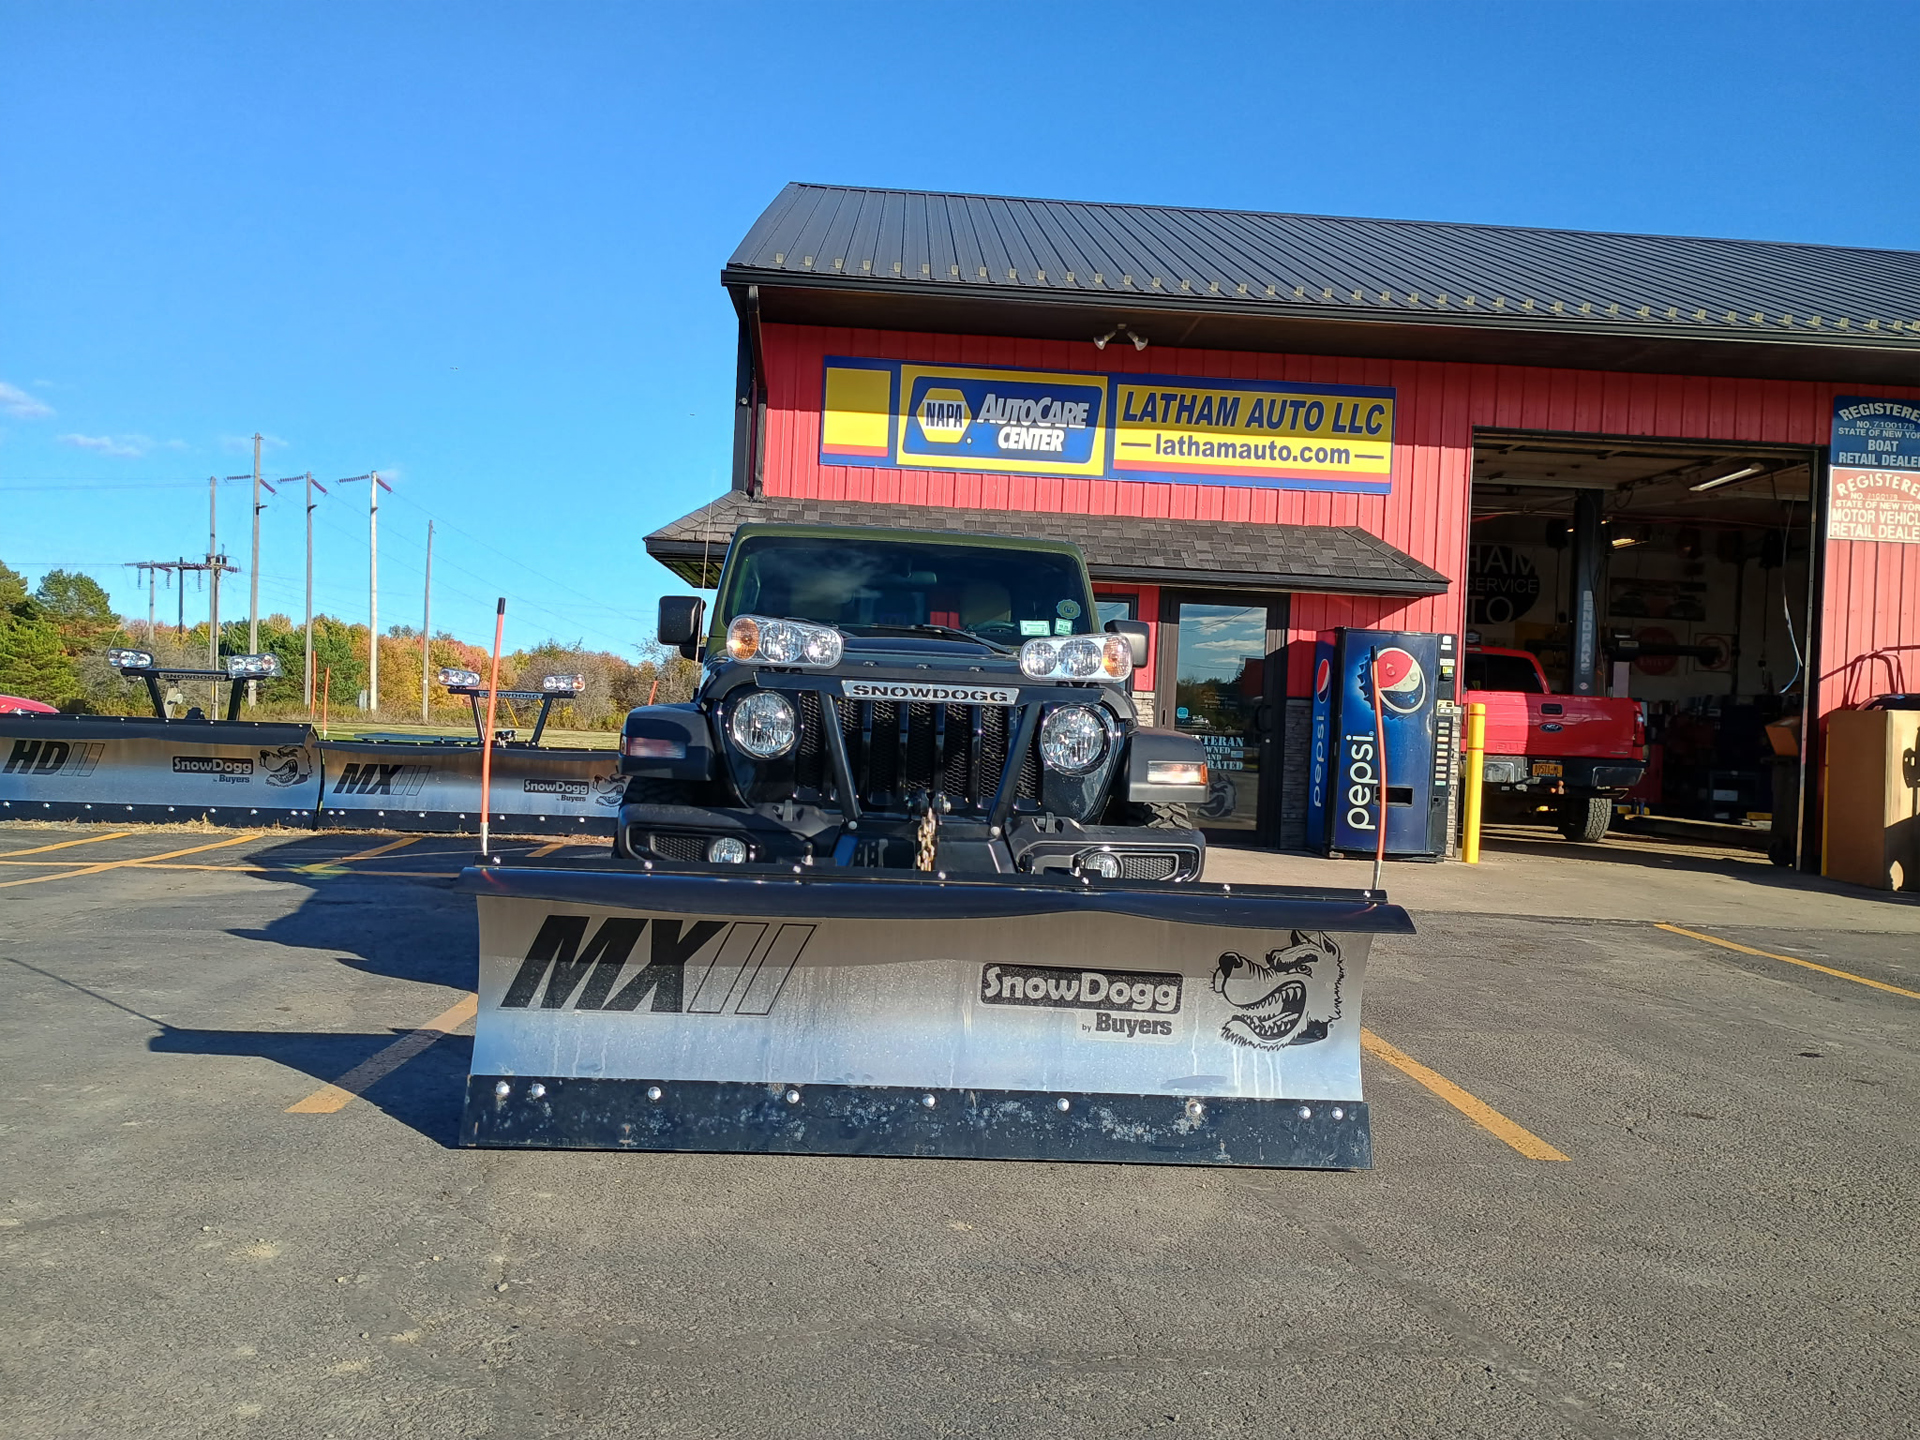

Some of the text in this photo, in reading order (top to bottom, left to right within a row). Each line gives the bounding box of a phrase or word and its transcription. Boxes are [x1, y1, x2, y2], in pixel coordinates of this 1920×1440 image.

[926, 402, 963, 428] NAPA
[977, 394, 1090, 428] AUTOCARE
[1122, 391, 1385, 435] LATHAM AUTO LLC
[1838, 403, 1920, 424] REGISTERE
[1838, 427, 1867, 436] STATE
[1868, 429, 1880, 437] OF
[1882, 430, 1902, 438] NEW
[1856, 420, 1872, 429] NO.
[997, 426, 1065, 452] CENTER
[1867, 439, 1899, 452] BOAT
[1155, 433, 1350, 464] lathamauto.com
[1838, 452, 1878, 466] RETAIL
[1836, 473, 1920, 499] REGISTERE
[1836, 499, 1920, 511] STATE OF NEW YOR
[1850, 493, 1864, 501] NO.
[1832, 508, 1920, 526] MOTOR VEHICL
[1832, 522, 1920, 540] RETAIL DEALE
[163, 673, 222, 681] SNOWDOGG
[481, 691, 540, 699] SOWDOGG
[853, 683, 1008, 702] SNOWDOGG
[1204, 746, 1231, 754] WNED
[174, 757, 252, 774] SnowDogg
[1313, 716, 1325, 807] pepsi
[219, 774, 250, 785] Buyers
[524, 779, 589, 795] SnowDogg
[1346, 734, 1379, 830] pepsi
[561, 794, 587, 802] Buyers
[982, 967, 1179, 1012] SnowDogg
[1081, 1013, 1172, 1037] by Buyers
